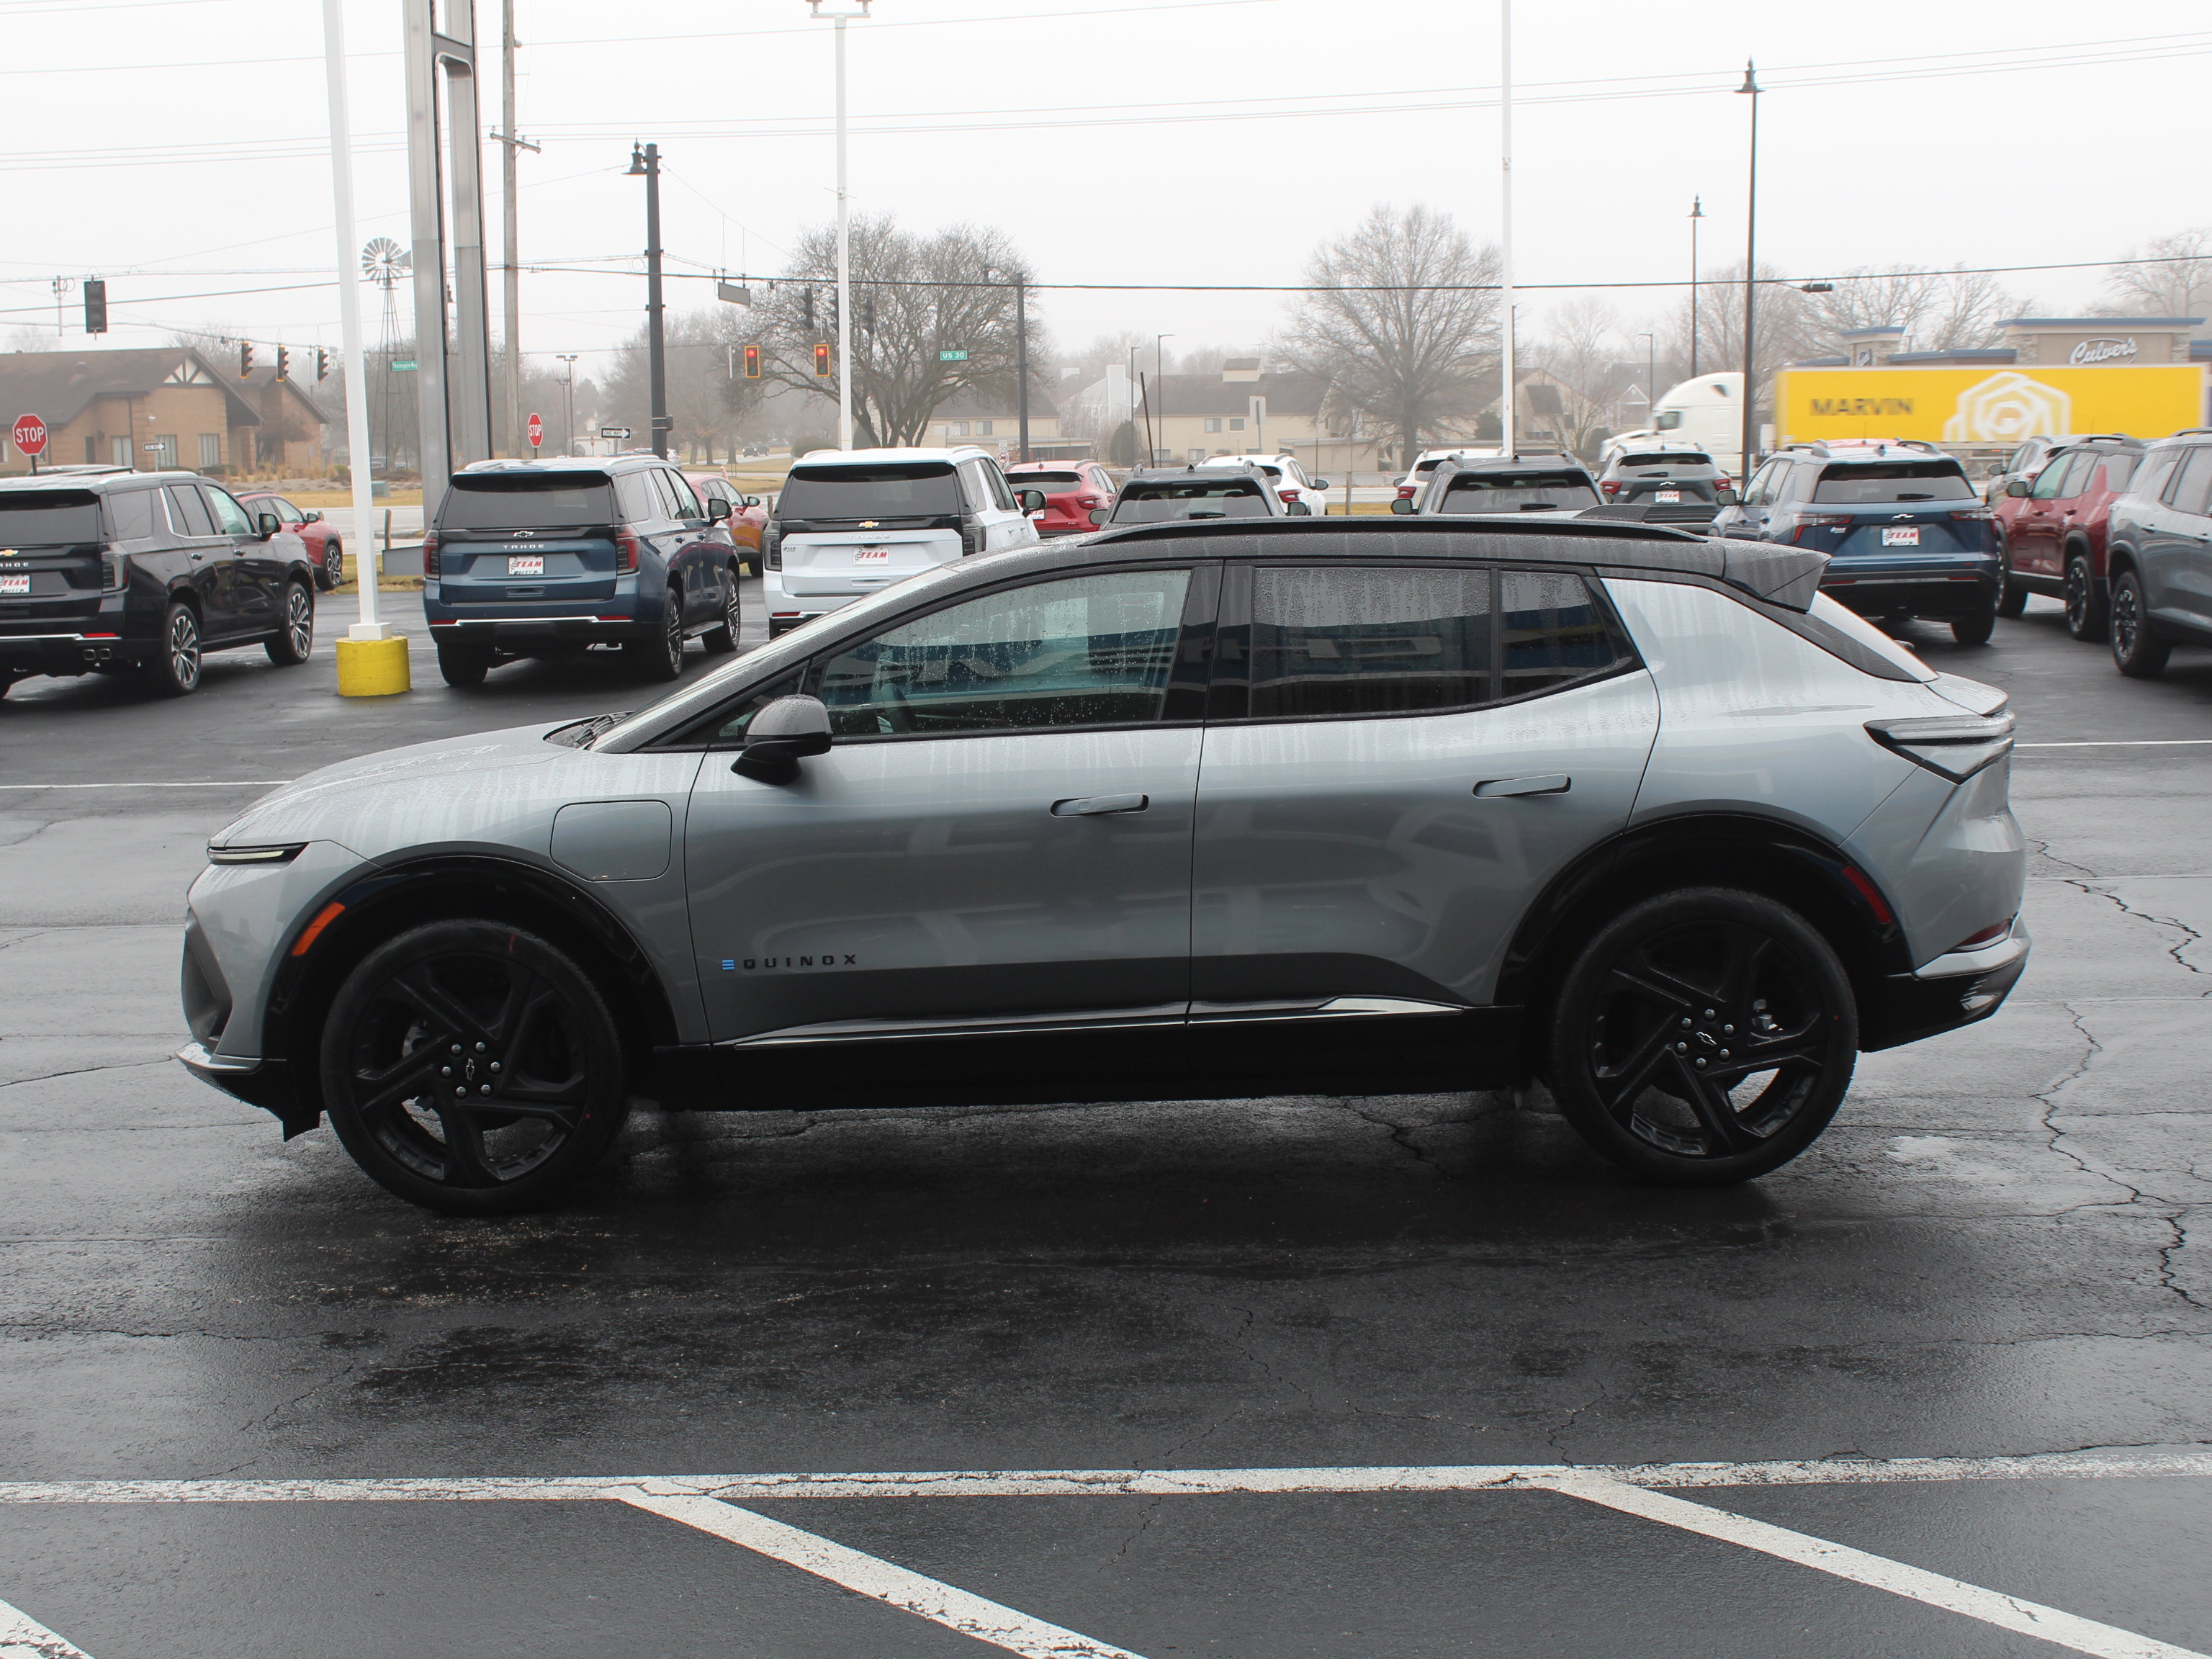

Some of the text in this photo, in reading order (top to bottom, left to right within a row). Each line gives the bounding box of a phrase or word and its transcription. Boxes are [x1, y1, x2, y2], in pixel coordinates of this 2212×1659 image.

[2069, 337, 2138, 364] Culver's
[1810, 398, 1914, 415] MARVIN
[16, 426, 45, 444] STOP
[529, 424, 541, 436] STOP
[721, 954, 857, 971] EQUINOX
